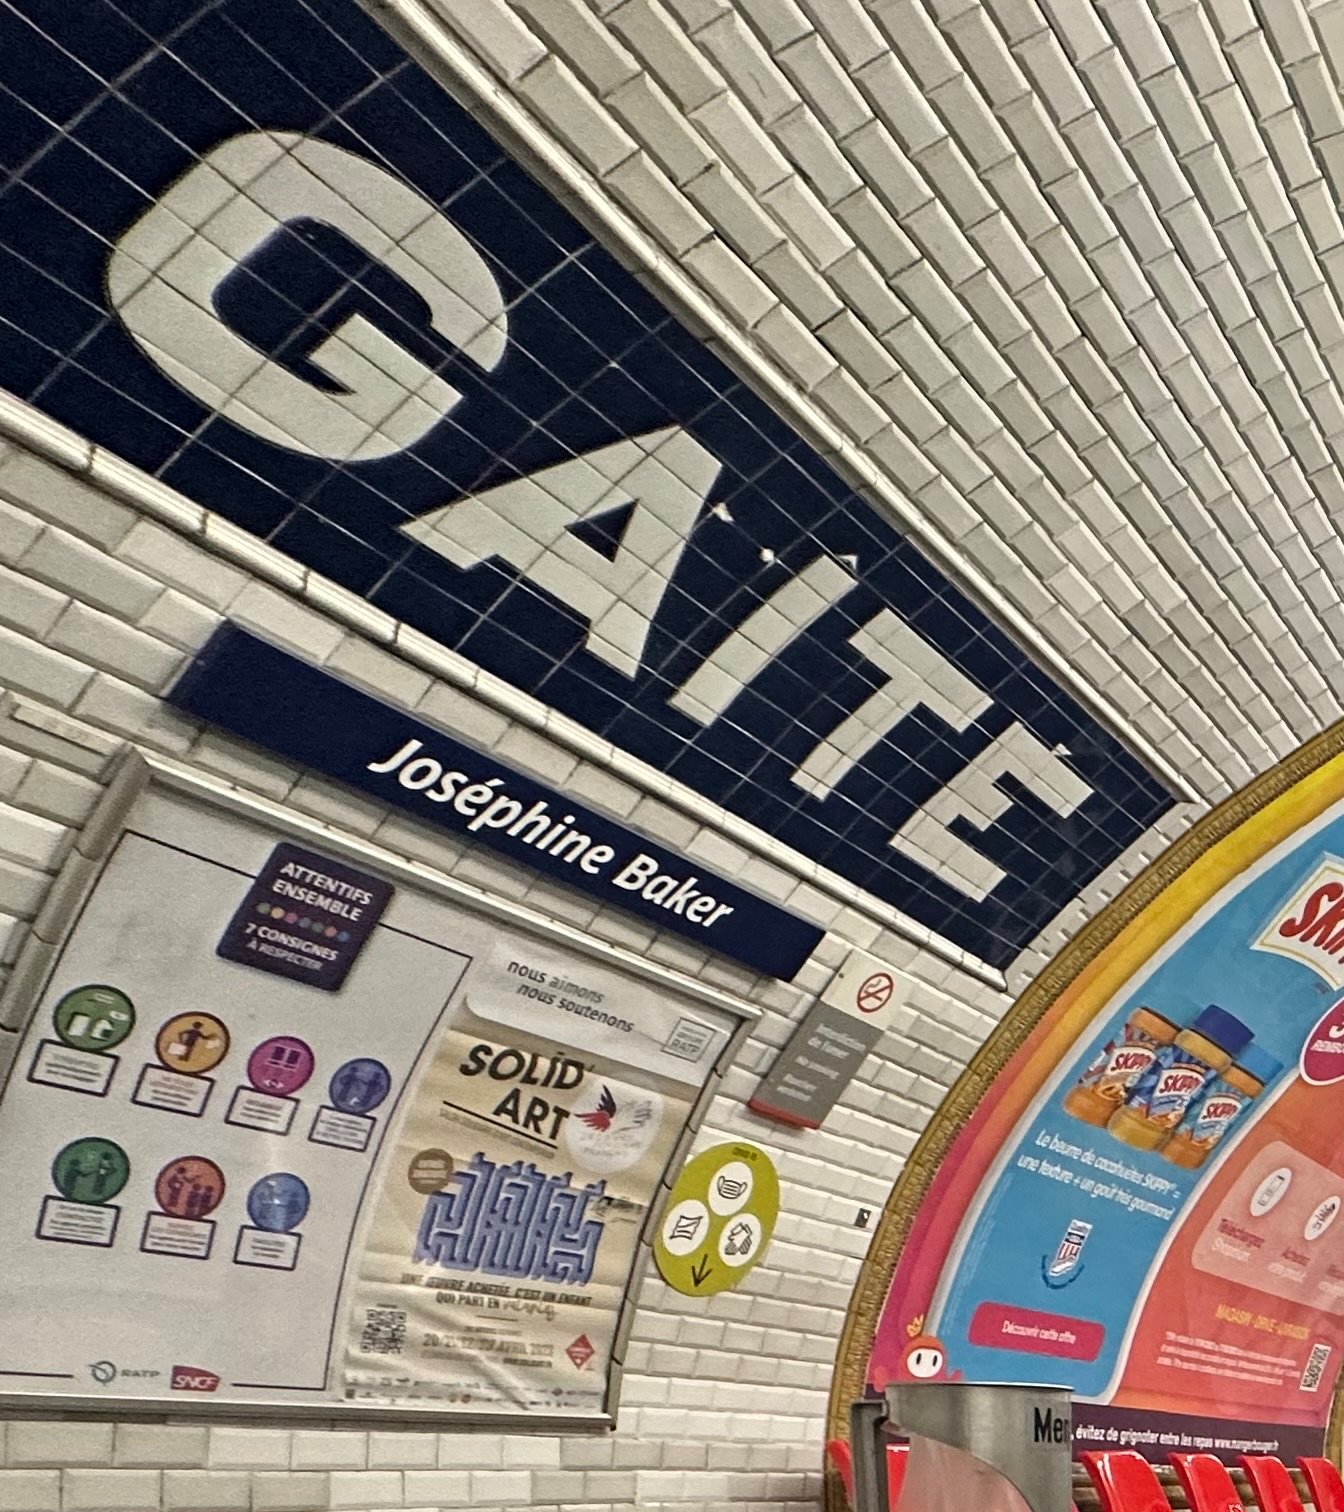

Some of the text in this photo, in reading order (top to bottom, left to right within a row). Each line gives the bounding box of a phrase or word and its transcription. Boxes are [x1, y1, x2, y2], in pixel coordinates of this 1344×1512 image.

[366, 738, 735, 928] Joséphine Baker
[272, 878, 363, 921] ENSEMBLE
[280, 862, 373, 905] ATTENTIFS
[244, 922, 339, 961] 7 CONSIGNES
[258, 943, 323, 971] RESPECTER
[507, 960, 606, 1004] nous aimons
[517, 982, 636, 1034] nous soutenons
[492, 1087, 571, 1140] ART
[1035, 1129, 1051, 1148] Le
[1080, 1147, 1096, 1166] de
[1017, 1153, 1040, 1172] une
[1037, 1158, 1074, 1184] texture
[1079, 1177, 1095, 1193] un
[458, 1294, 485, 1308] PART
[487, 1296, 500, 1309] EN
[120, 1368, 161, 1379] RATP
[172, 1375, 219, 1389] SNCF
[1076, 1423, 1106, 1441] évitez
[1106, 1426, 1119, 1442] de
[1120, 1428, 1160, 1447] grignoter
[1159, 1431, 1180, 1446] entre
[1180, 1432, 1193, 1446] les
[1193, 1436, 1213, 1450] repas
